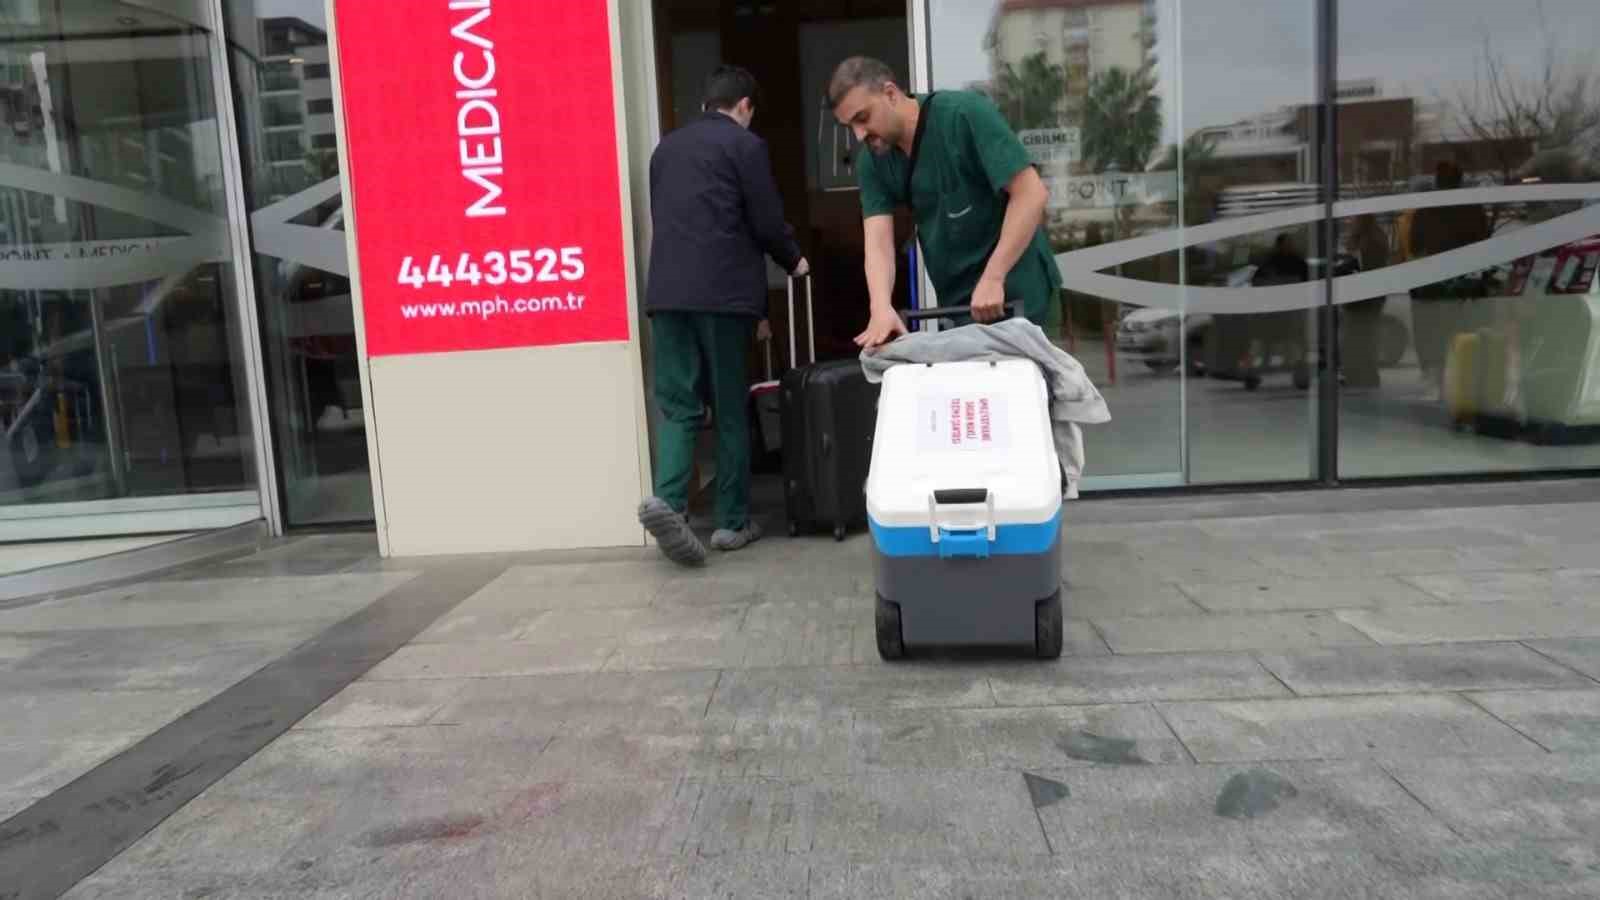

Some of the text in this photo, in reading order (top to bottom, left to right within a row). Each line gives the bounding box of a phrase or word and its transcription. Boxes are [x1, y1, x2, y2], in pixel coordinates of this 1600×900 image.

[448, 0, 507, 217] MEDICAL
[398, 246, 586, 289] 4443525
[400, 292, 586, 320] www.mph.com.tr
